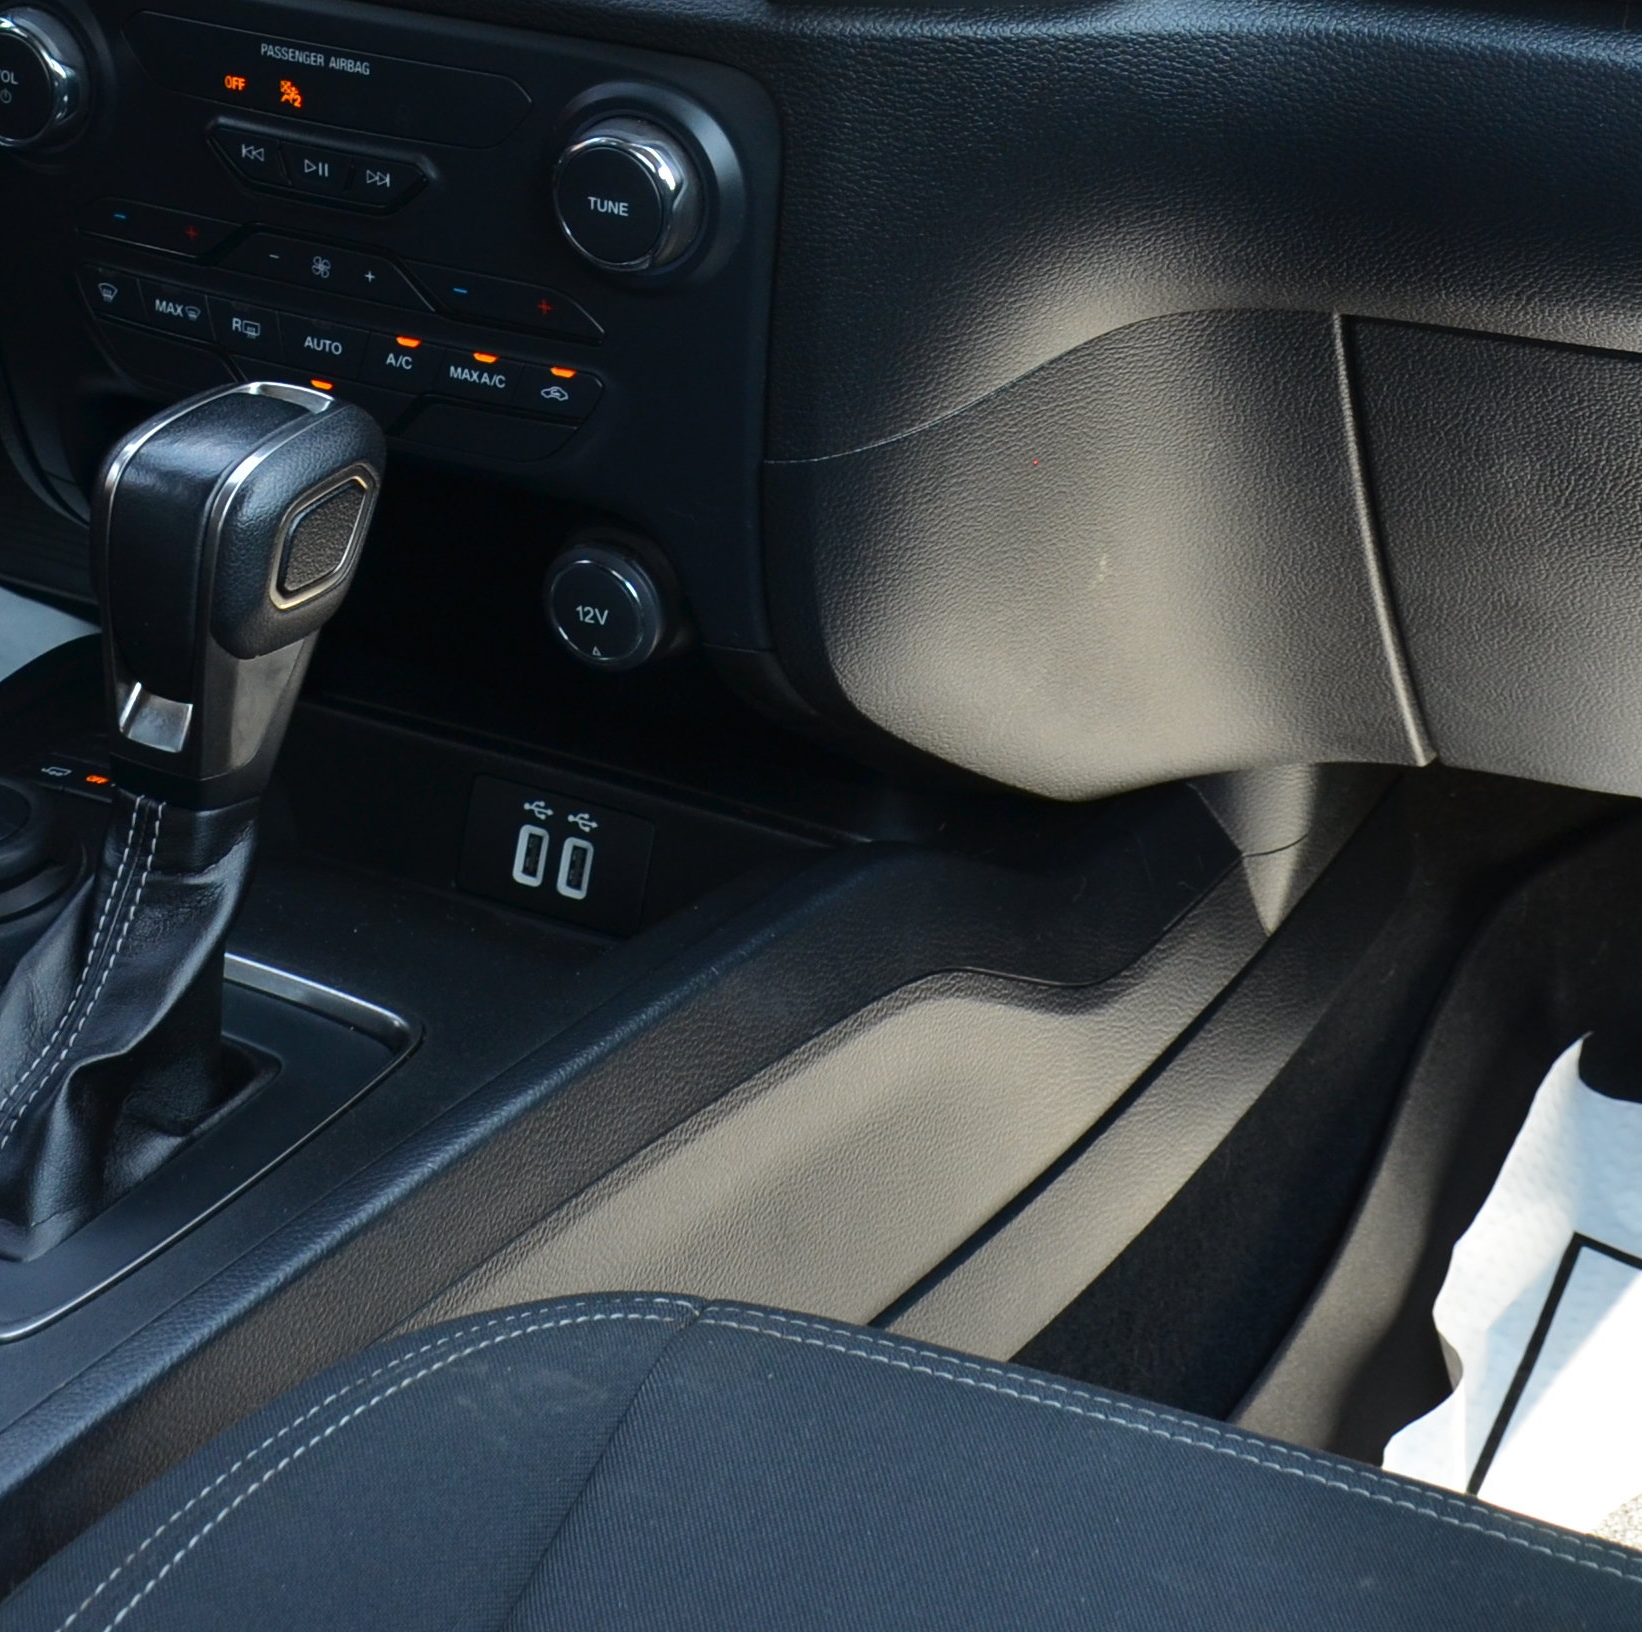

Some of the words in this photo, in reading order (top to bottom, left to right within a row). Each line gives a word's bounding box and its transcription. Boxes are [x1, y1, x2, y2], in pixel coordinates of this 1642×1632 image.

[260, 43, 325, 67] PASSENGER
[328, 56, 371, 76] AIRBAG
[223, 74, 246, 92] OFF
[587, 196, 629, 217] TUNE
[154, 299, 185, 318] MAX
[231, 317, 243, 333] R
[303, 336, 343, 355] AUTO
[386, 353, 413, 370] A/C
[575, 605, 609, 626] 12V
